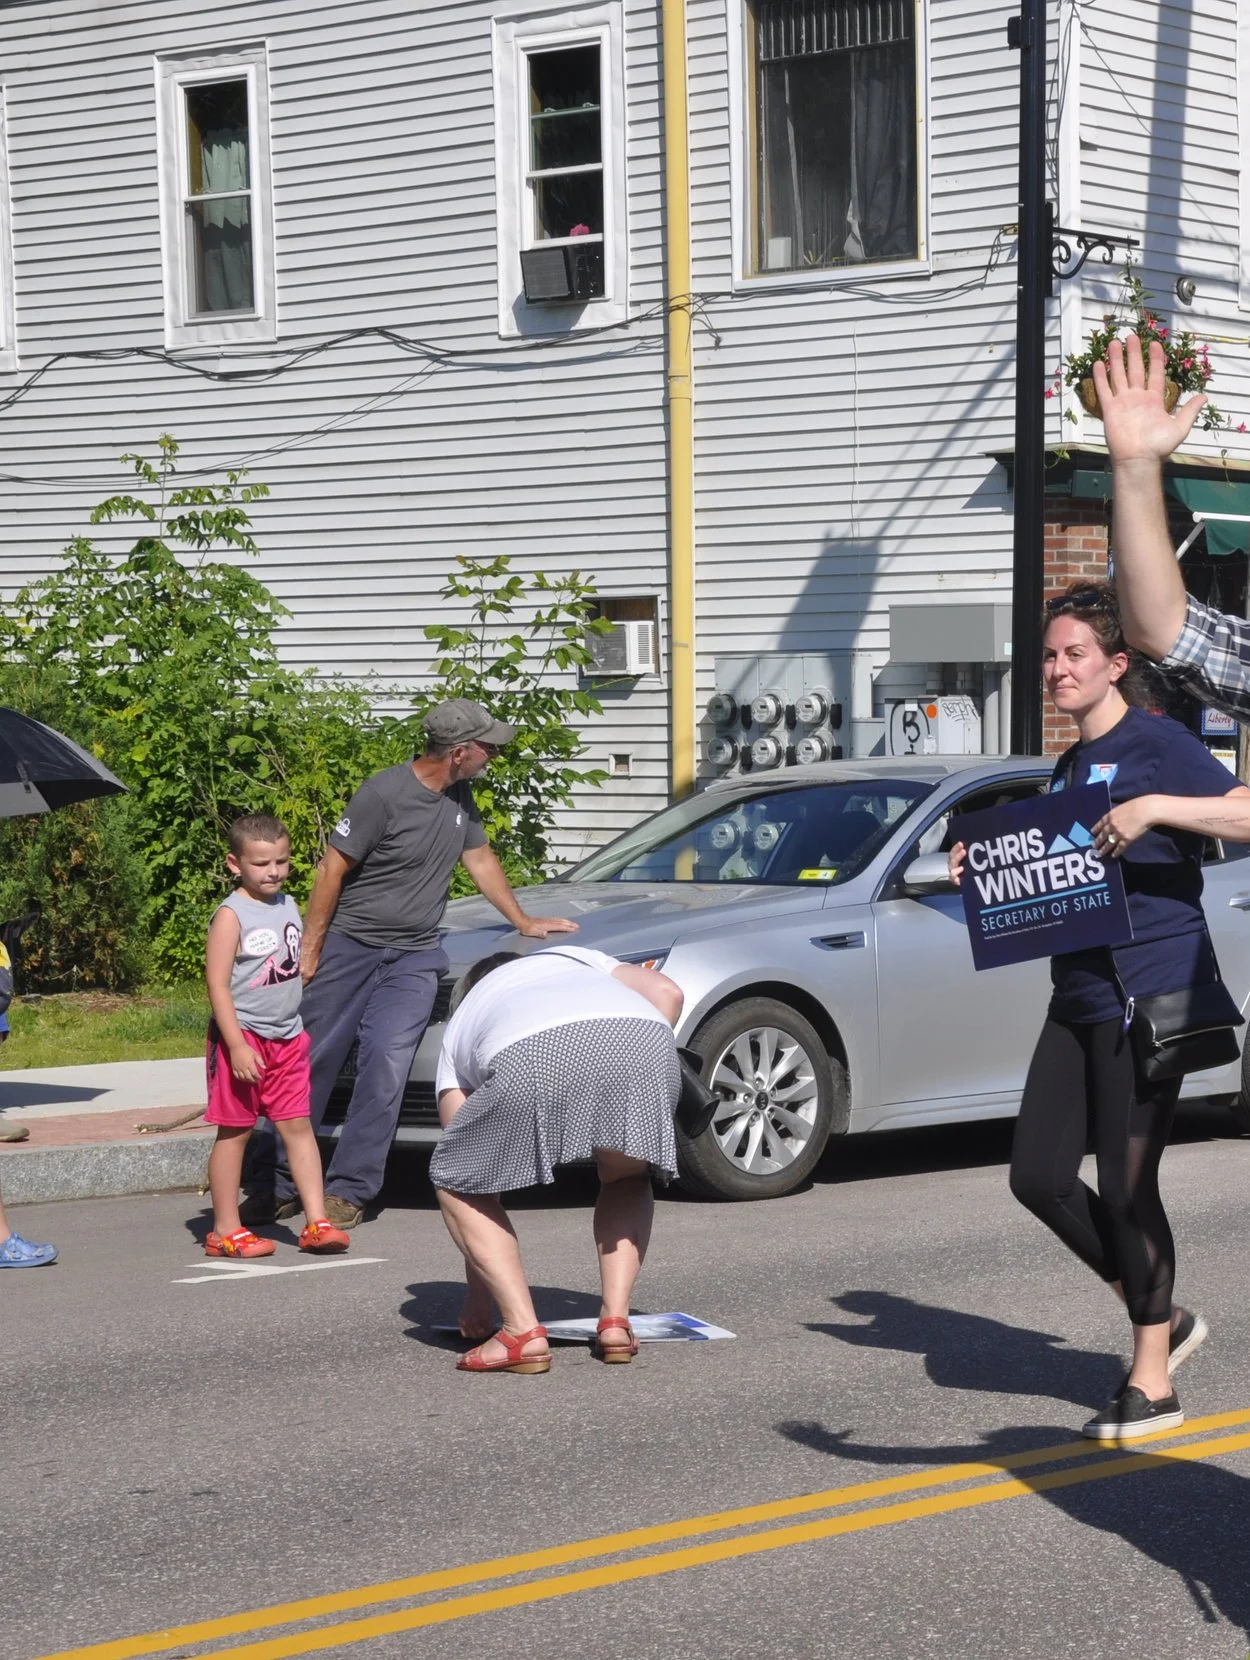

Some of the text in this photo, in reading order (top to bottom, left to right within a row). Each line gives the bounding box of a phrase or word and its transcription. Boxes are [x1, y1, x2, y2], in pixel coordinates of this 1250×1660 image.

[1208, 712, 1232, 728] Liberty
[968, 827, 1045, 872] CHRIS
[974, 849, 1106, 906] WINTERS
[981, 904, 1047, 932] SECRETARY
[1050, 899, 1070, 917] OF
[1073, 891, 1112, 913] STATE
